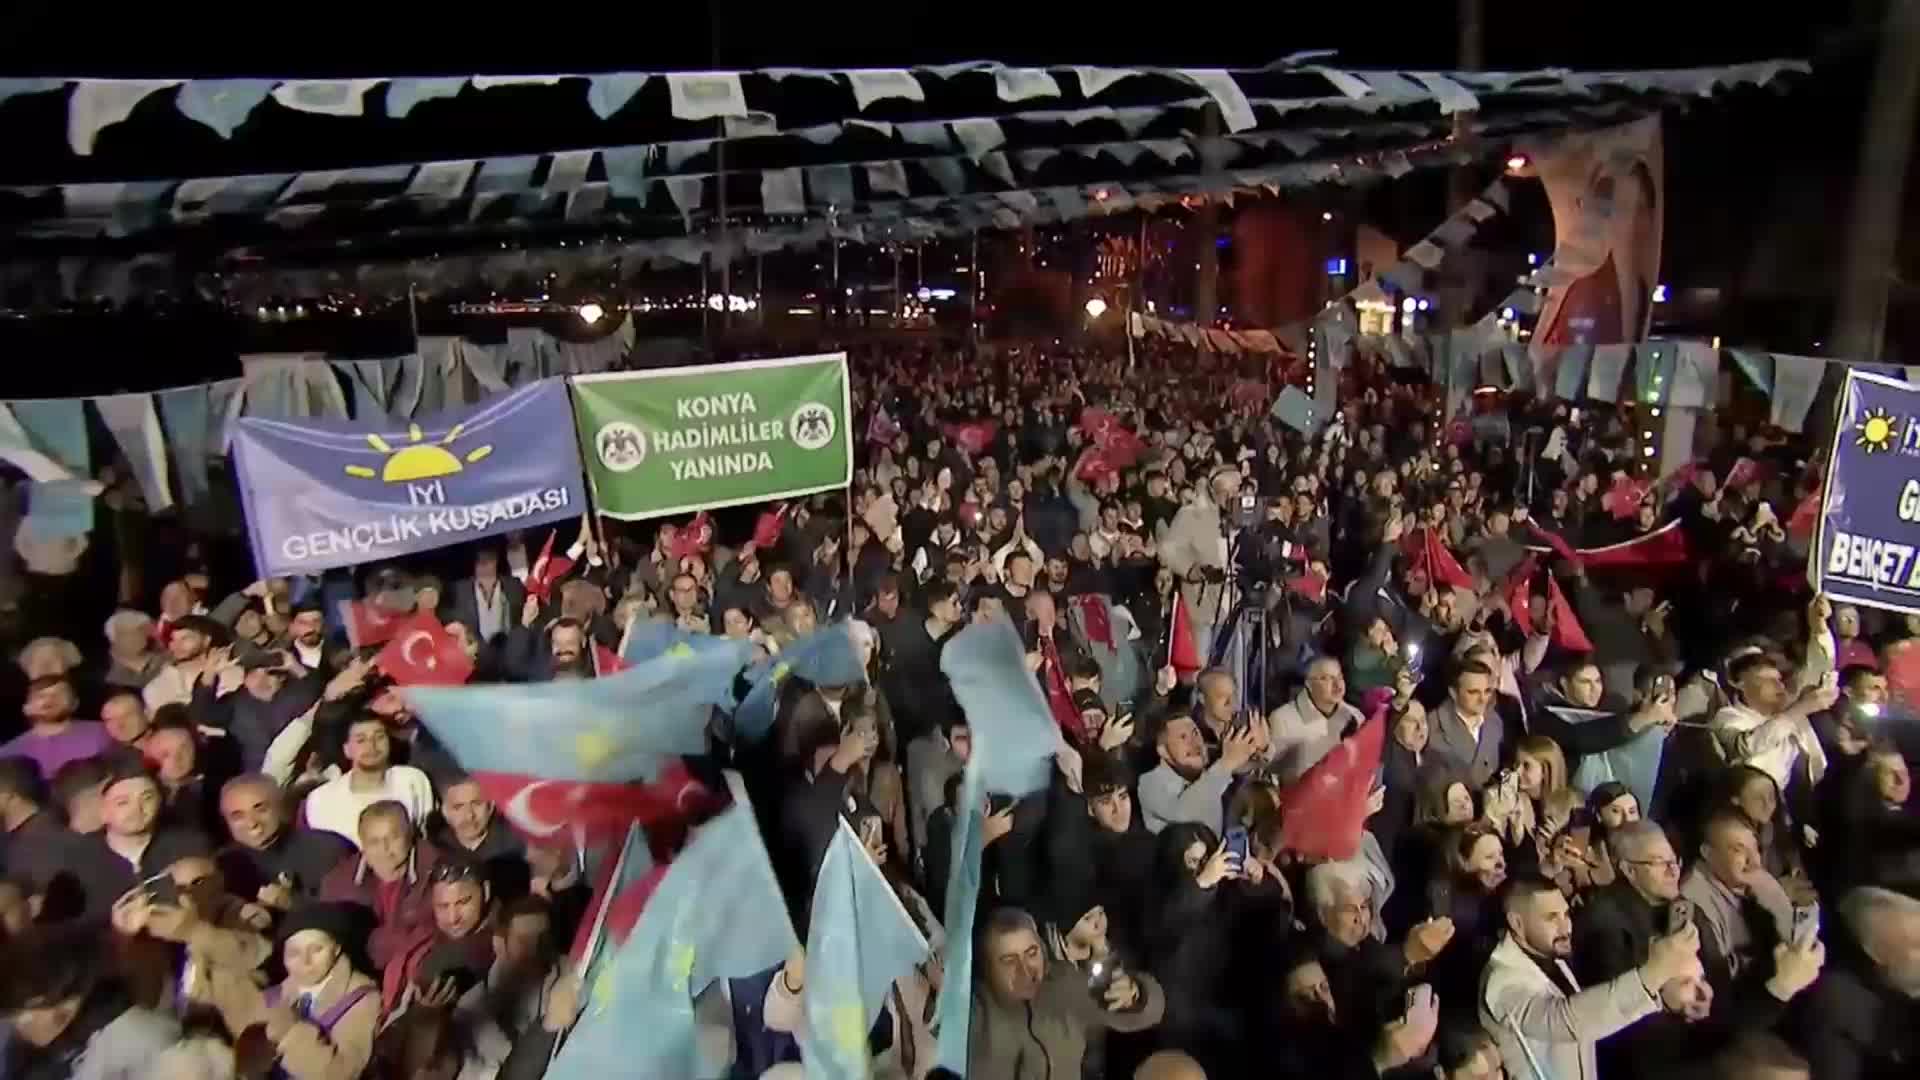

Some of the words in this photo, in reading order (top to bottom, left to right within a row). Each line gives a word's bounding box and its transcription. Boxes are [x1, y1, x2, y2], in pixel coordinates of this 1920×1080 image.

[677, 391, 757, 419] KONYA
[653, 416, 785, 454] HADİMLİLER
[670, 451, 774, 481] YANINDA
[281, 514, 423, 561] GENÇLİK
[429, 487, 569, 535] KUŞADASI
